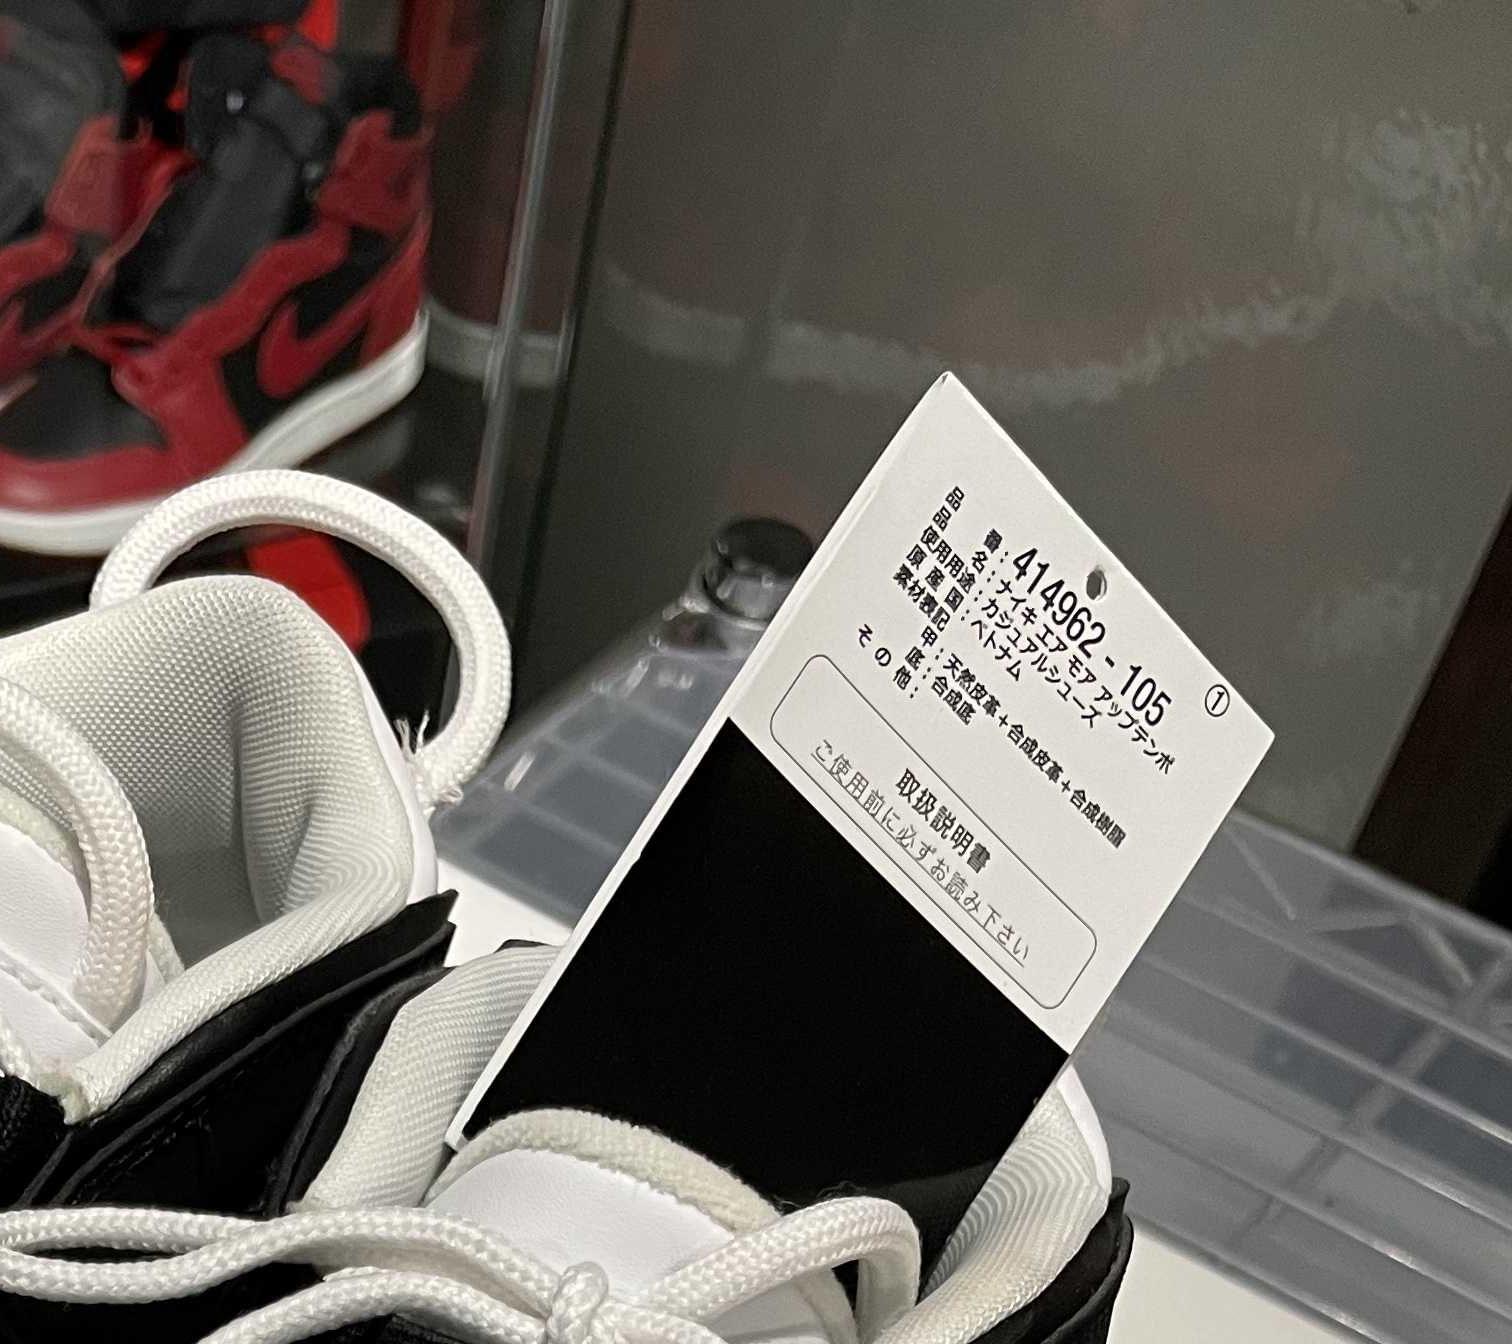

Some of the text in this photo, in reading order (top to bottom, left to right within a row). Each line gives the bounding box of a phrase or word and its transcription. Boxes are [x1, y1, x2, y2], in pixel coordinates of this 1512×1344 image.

[971, 618, 1023, 681] ベトナム
[982, 597, 1102, 728] カジュアルシューズ
[813, 739, 1030, 962] ご使用前に必ずお読み下さい
[896, 768, 991, 874] 取扱説明書
